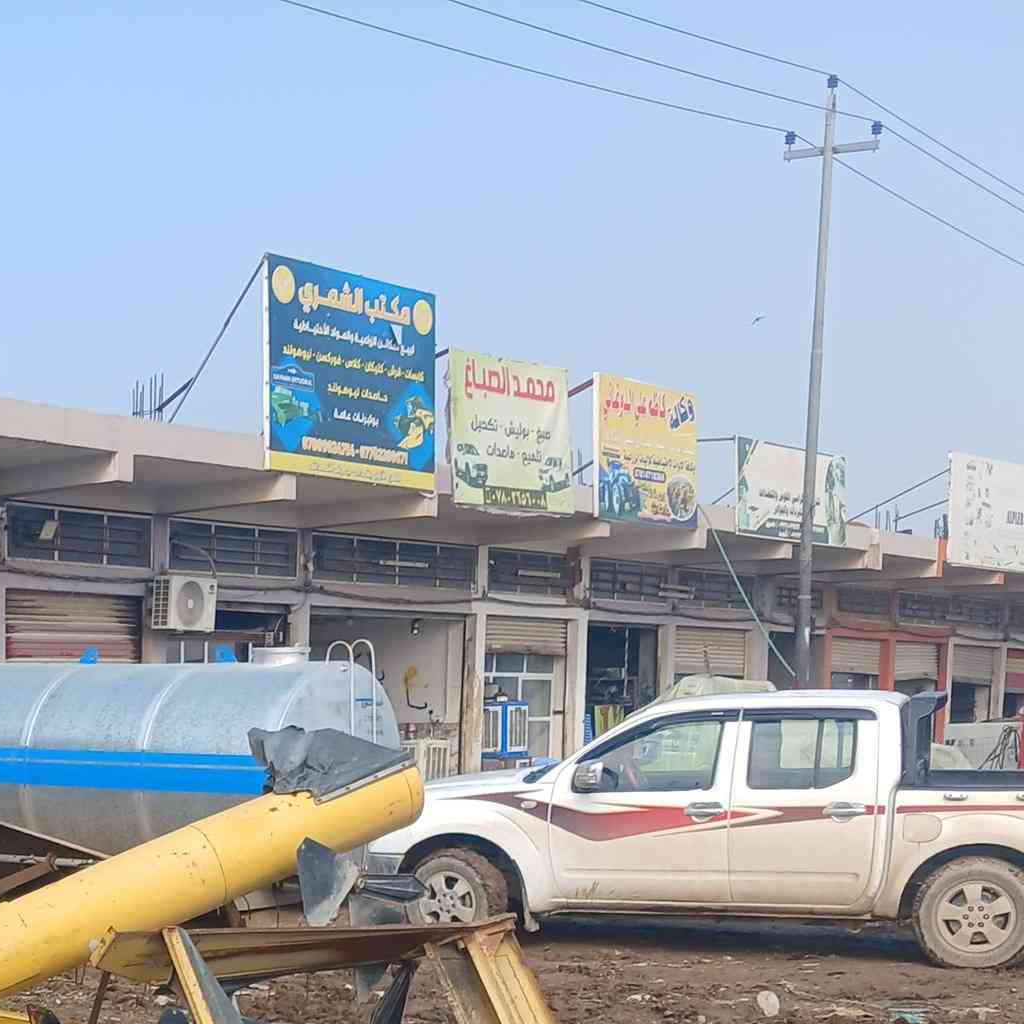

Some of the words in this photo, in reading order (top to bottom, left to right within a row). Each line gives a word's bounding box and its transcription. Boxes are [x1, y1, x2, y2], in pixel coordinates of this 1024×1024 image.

[298, 281, 364, 314] الشمري
[364, 294, 411, 325] مكتب
[463, 356, 511, 399] الصباغ
[512, 374, 555, 402] محمد
